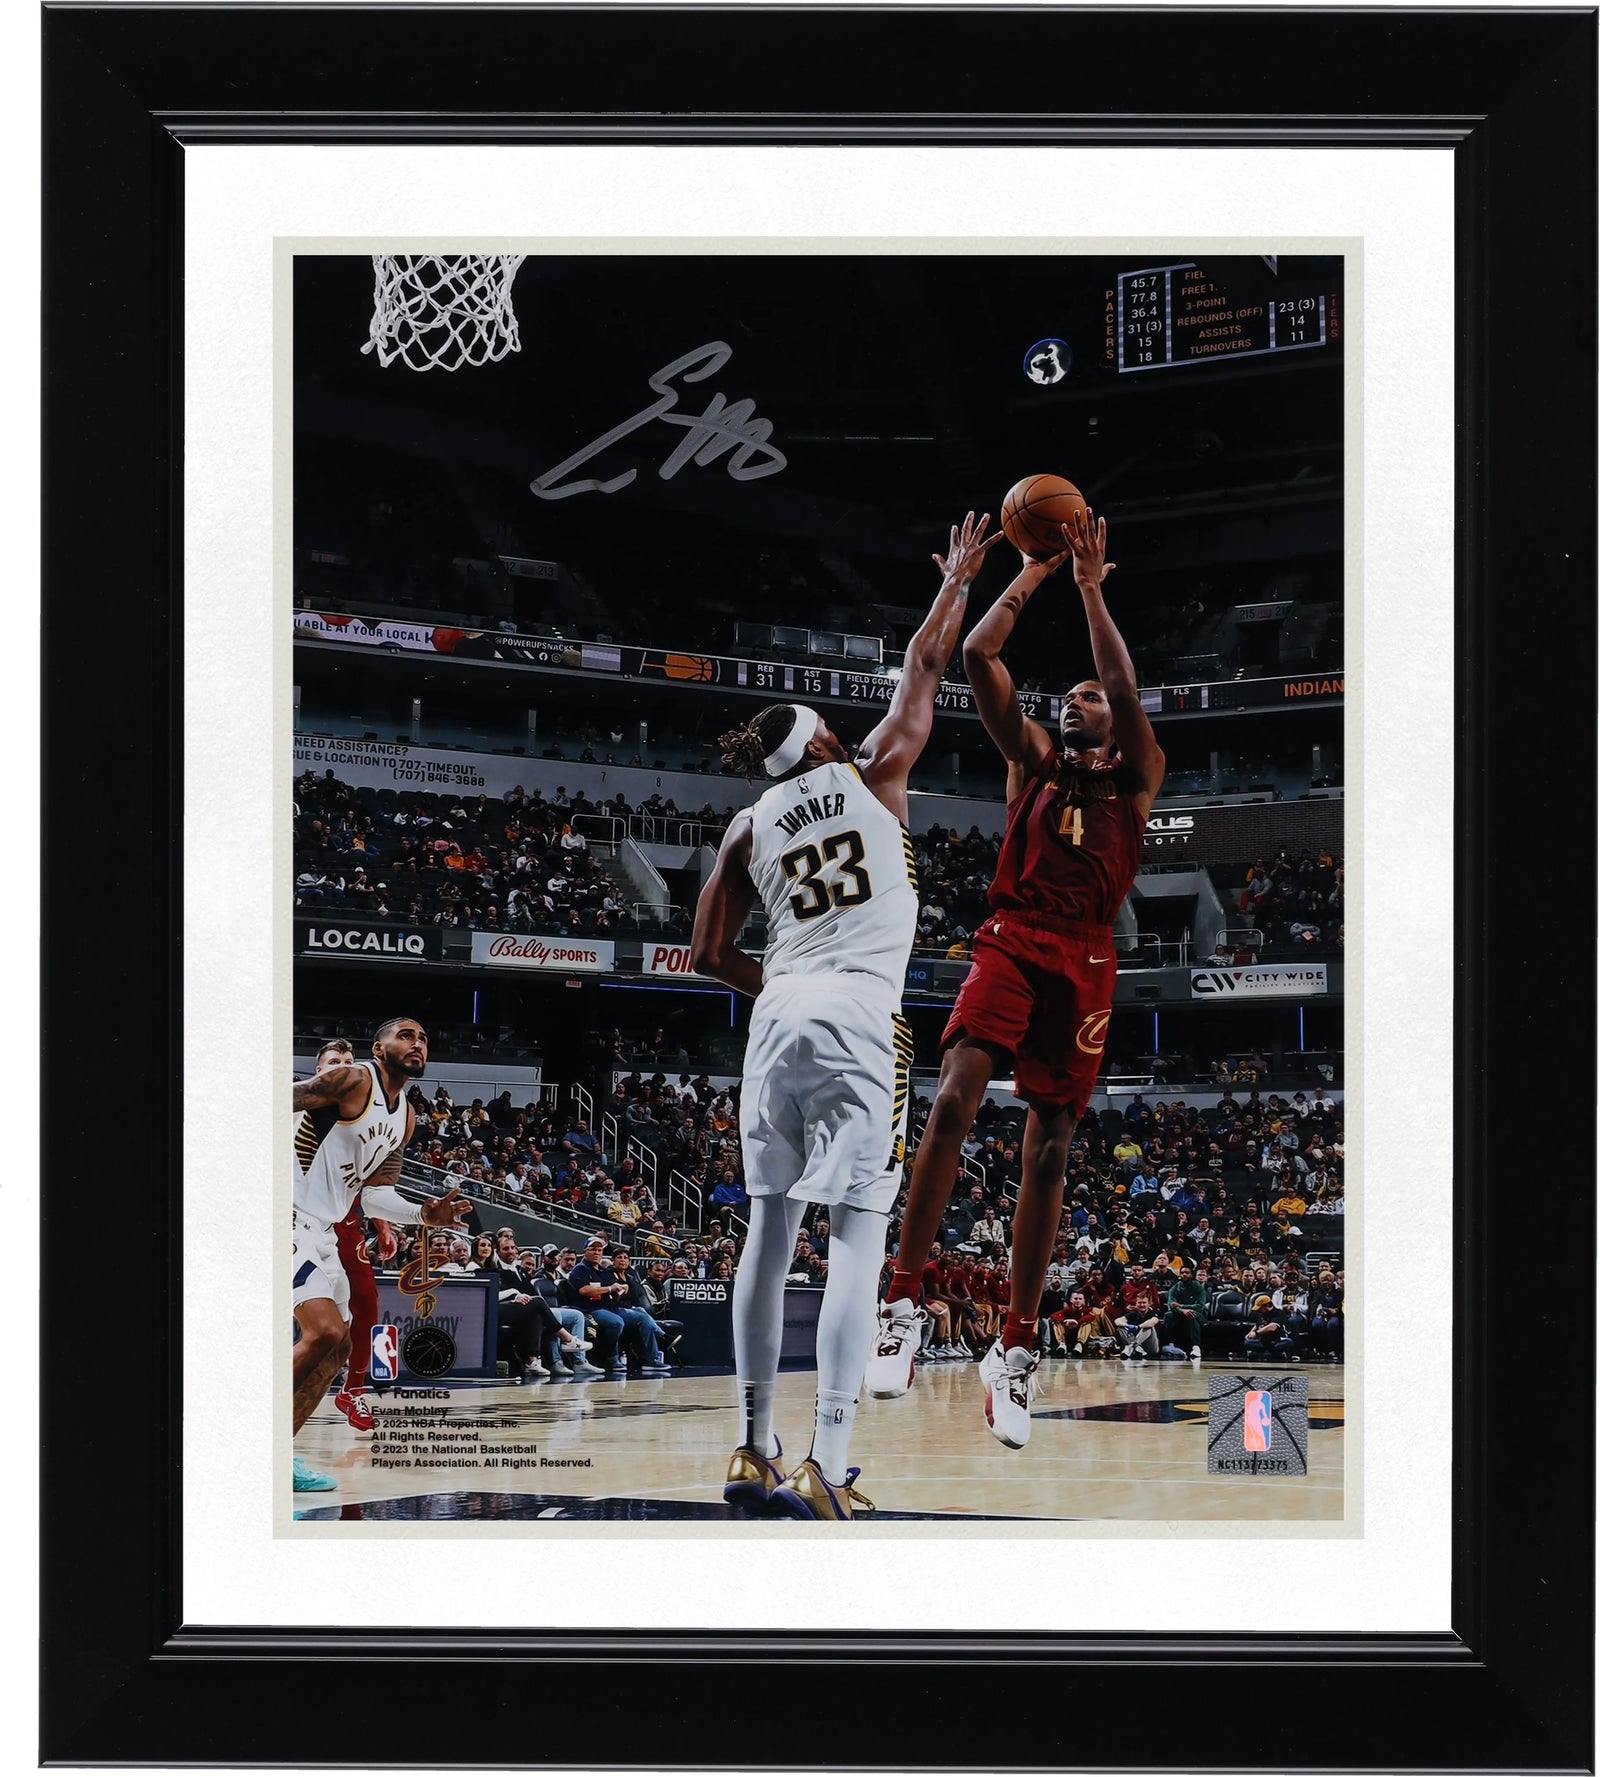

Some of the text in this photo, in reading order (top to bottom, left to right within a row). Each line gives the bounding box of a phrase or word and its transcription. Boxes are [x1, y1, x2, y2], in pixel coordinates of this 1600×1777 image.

[1131, 277, 1157, 289] 45.7
[1181, 284, 1207, 296] FREE
[1131, 291, 1157, 304] 77.8
[1279, 298, 1315, 313] 23 (3)
[1131, 307, 1157, 319] 36.4
[1177, 306, 1263, 326] REBOUNDS (OFF)
[1105, 290, 1114, 359] PACERS
[1128, 320, 1162, 334] 31 (3)
[1291, 315, 1305, 326] 14
[1199, 325, 1242, 338] ASSISTS
[1291, 331, 1304, 341] 11
[1138, 337, 1152, 348] 15
[1190, 339, 1252, 355] TURNOVERS
[1138, 352, 1153, 363] 18
[335, 624, 350, 634] AT
[353, 626, 383, 637] YOUR
[387, 630, 421, 642] LOCAL
[757, 664, 774, 673] REB
[804, 669, 821, 677] AST
[756, 673, 774, 687] 31
[804, 678, 821, 692] 15
[846, 674, 872, 684] FIELD
[850, 684, 894, 700] 21/46
[1031, 695, 1042, 703] FG
[294, 737, 408, 756] NEED ASSISTANCE?
[313, 751, 322, 761] &
[325, 752, 380, 767] LOCATION
[382, 757, 396, 768] TO
[398, 759, 477, 776] 707-TIMEOUT.
[393, 768, 485, 787] (707) 846-3688
[656, 777, 661, 787] 8
[774, 793, 845, 837] TURNER
[1058, 805, 1085, 846] 4
[780, 829, 873, 921] 33
[489, 936, 597, 965] Bally SPORTS
[1245, 971, 1324, 982] CITY WIDE
[535, 1067, 540, 1080] 7
[613, 1071, 619, 1084] 8
[673, 1282, 726, 1291] INDIANA
[685, 1291, 727, 1301] BOLD
